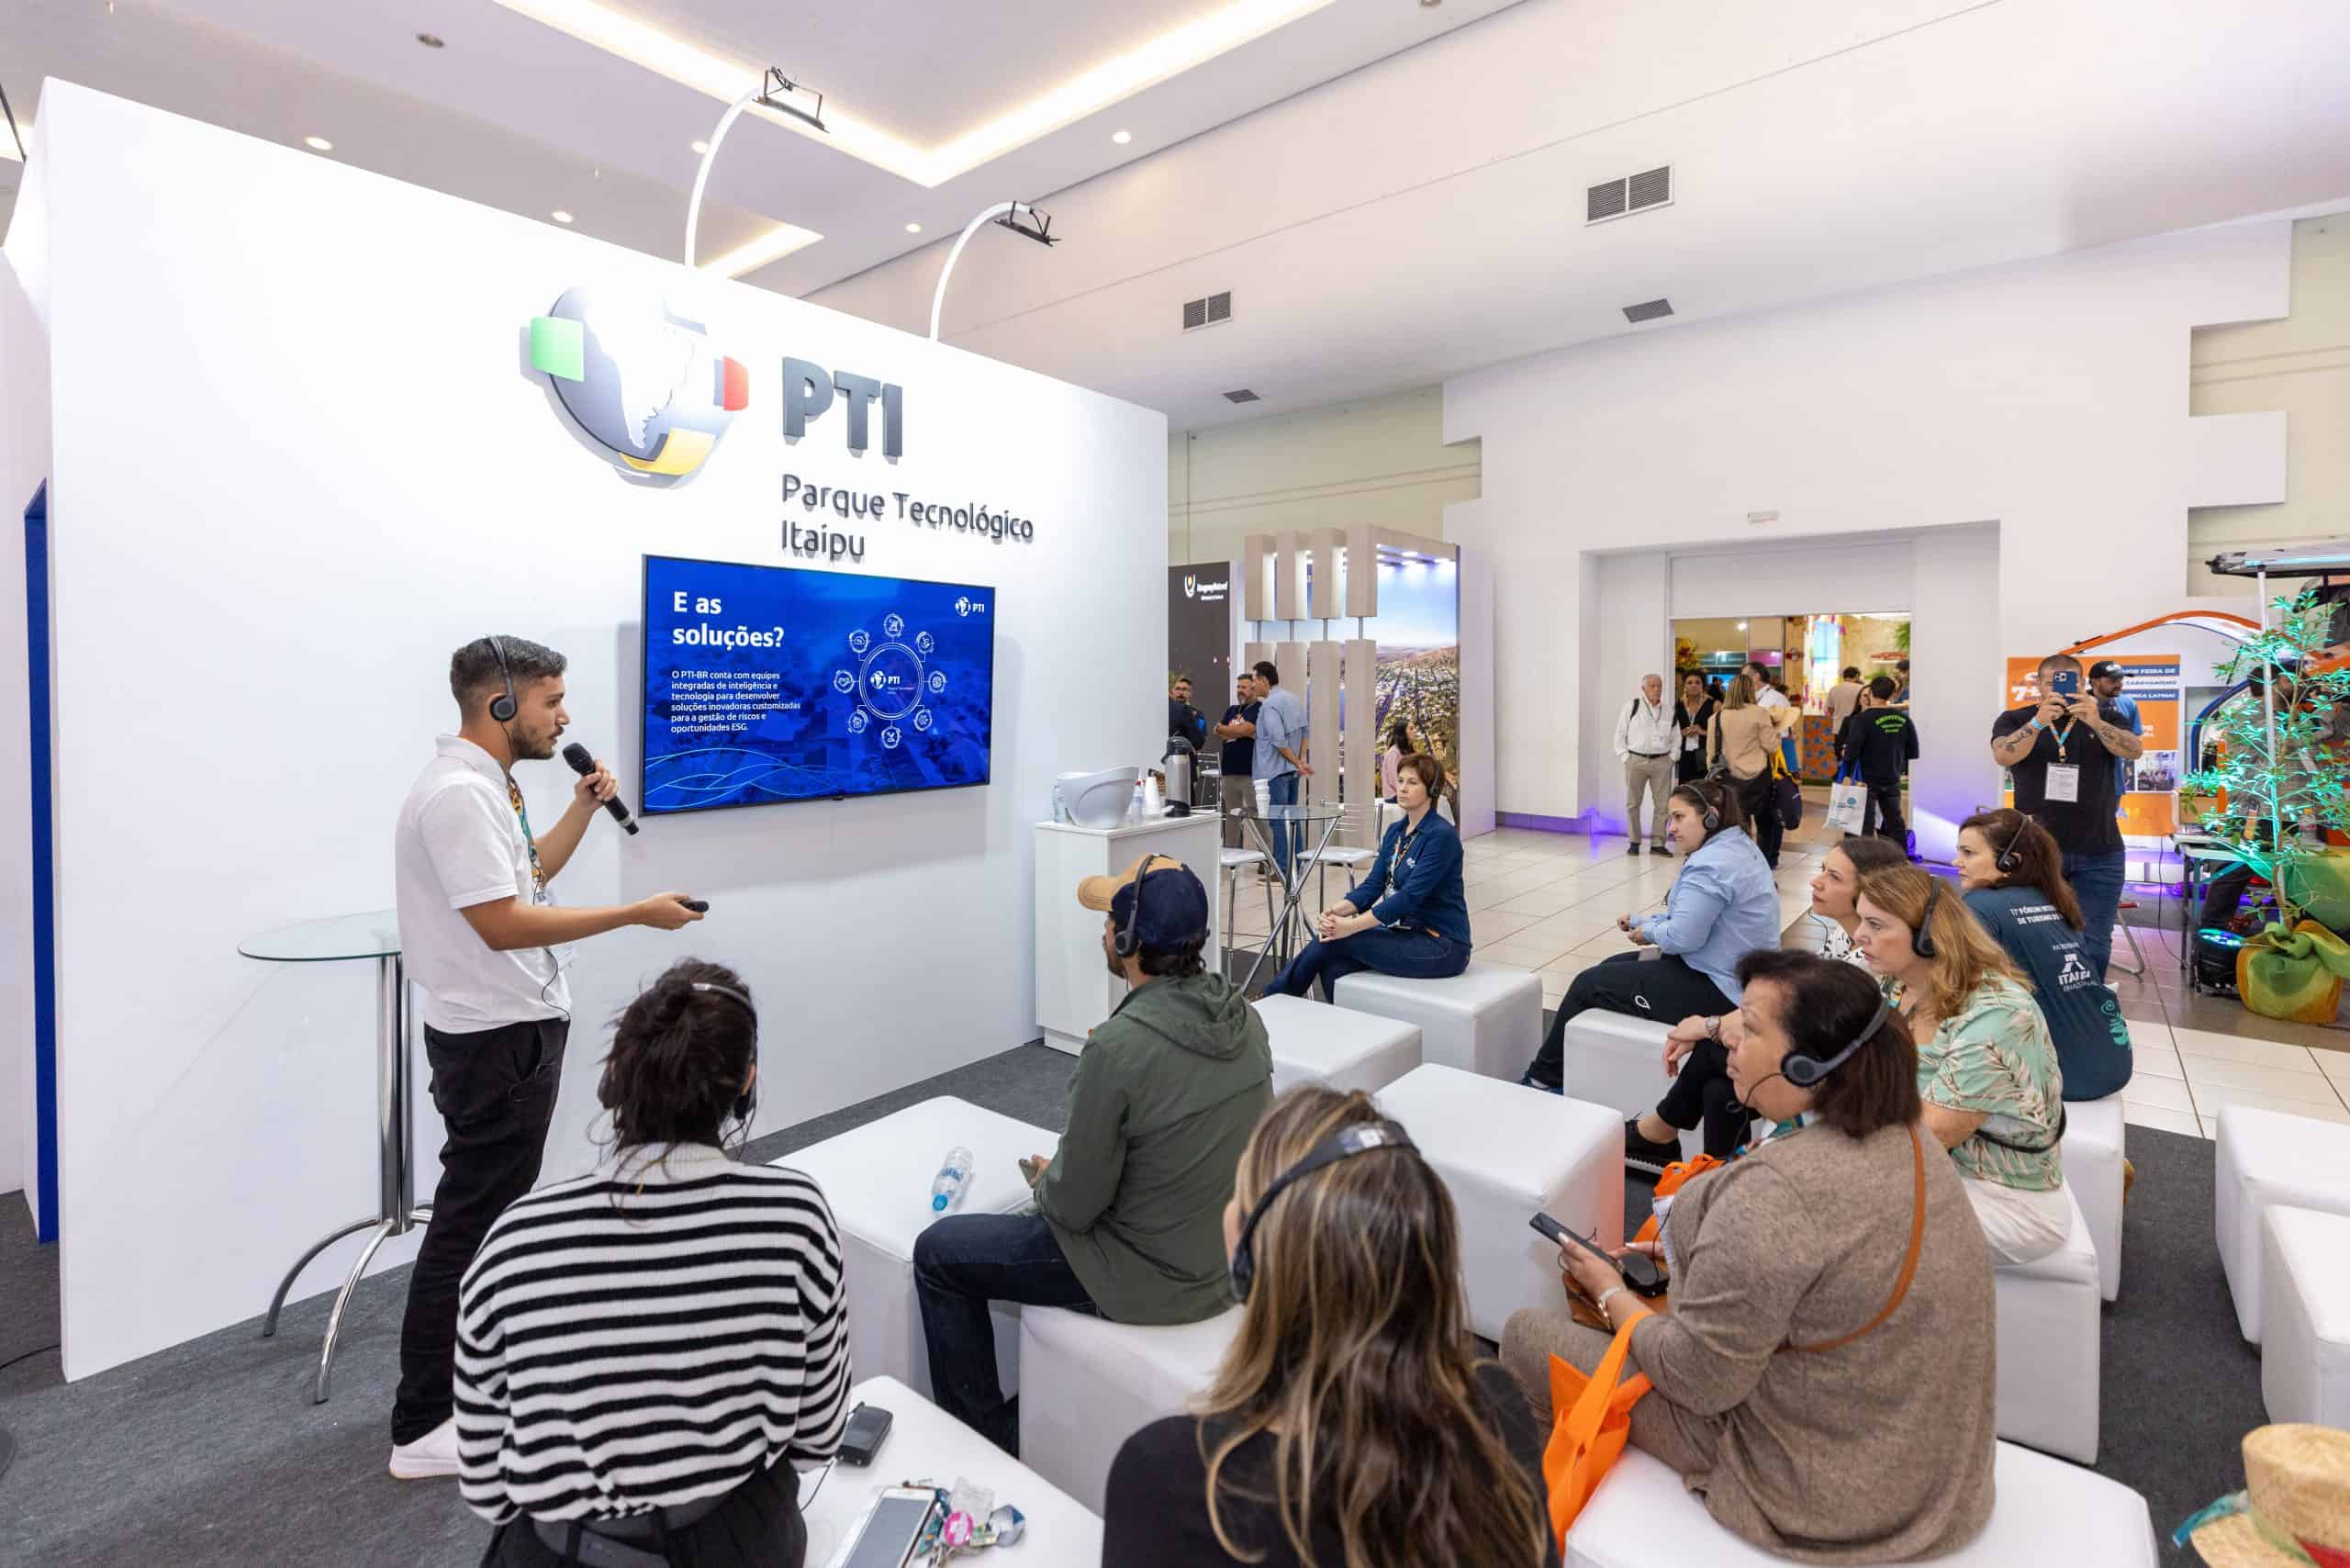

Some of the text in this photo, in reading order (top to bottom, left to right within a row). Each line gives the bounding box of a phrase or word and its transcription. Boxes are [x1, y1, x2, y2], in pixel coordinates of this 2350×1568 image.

[782, 356, 903, 457] PTI
[782, 474, 1034, 540] Parque Tecnológico
[781, 520, 866, 562] Itaipu
[674, 590, 722, 614] E as
[972, 602, 985, 612] PTI
[672, 622, 785, 651] soluções?
[671, 670, 679, 679] O
[681, 670, 709, 679] PTI-BR
[710, 671, 732, 679] conta
[751, 671, 780, 680] equipes
[671, 680, 715, 690] integradas
[716, 680, 727, 689] de
[728, 680, 772, 690] inteligência
[671, 691, 779, 701] tecnologia para desenvolver
[671, 700, 800, 711] soluções inovadoras customizadas
[671, 715, 689, 723] para
[698, 712, 725, 722] gestão
[727, 712, 737, 721] de
[738, 712, 760, 721] riscos
[671, 723, 730, 734] oportunidades
